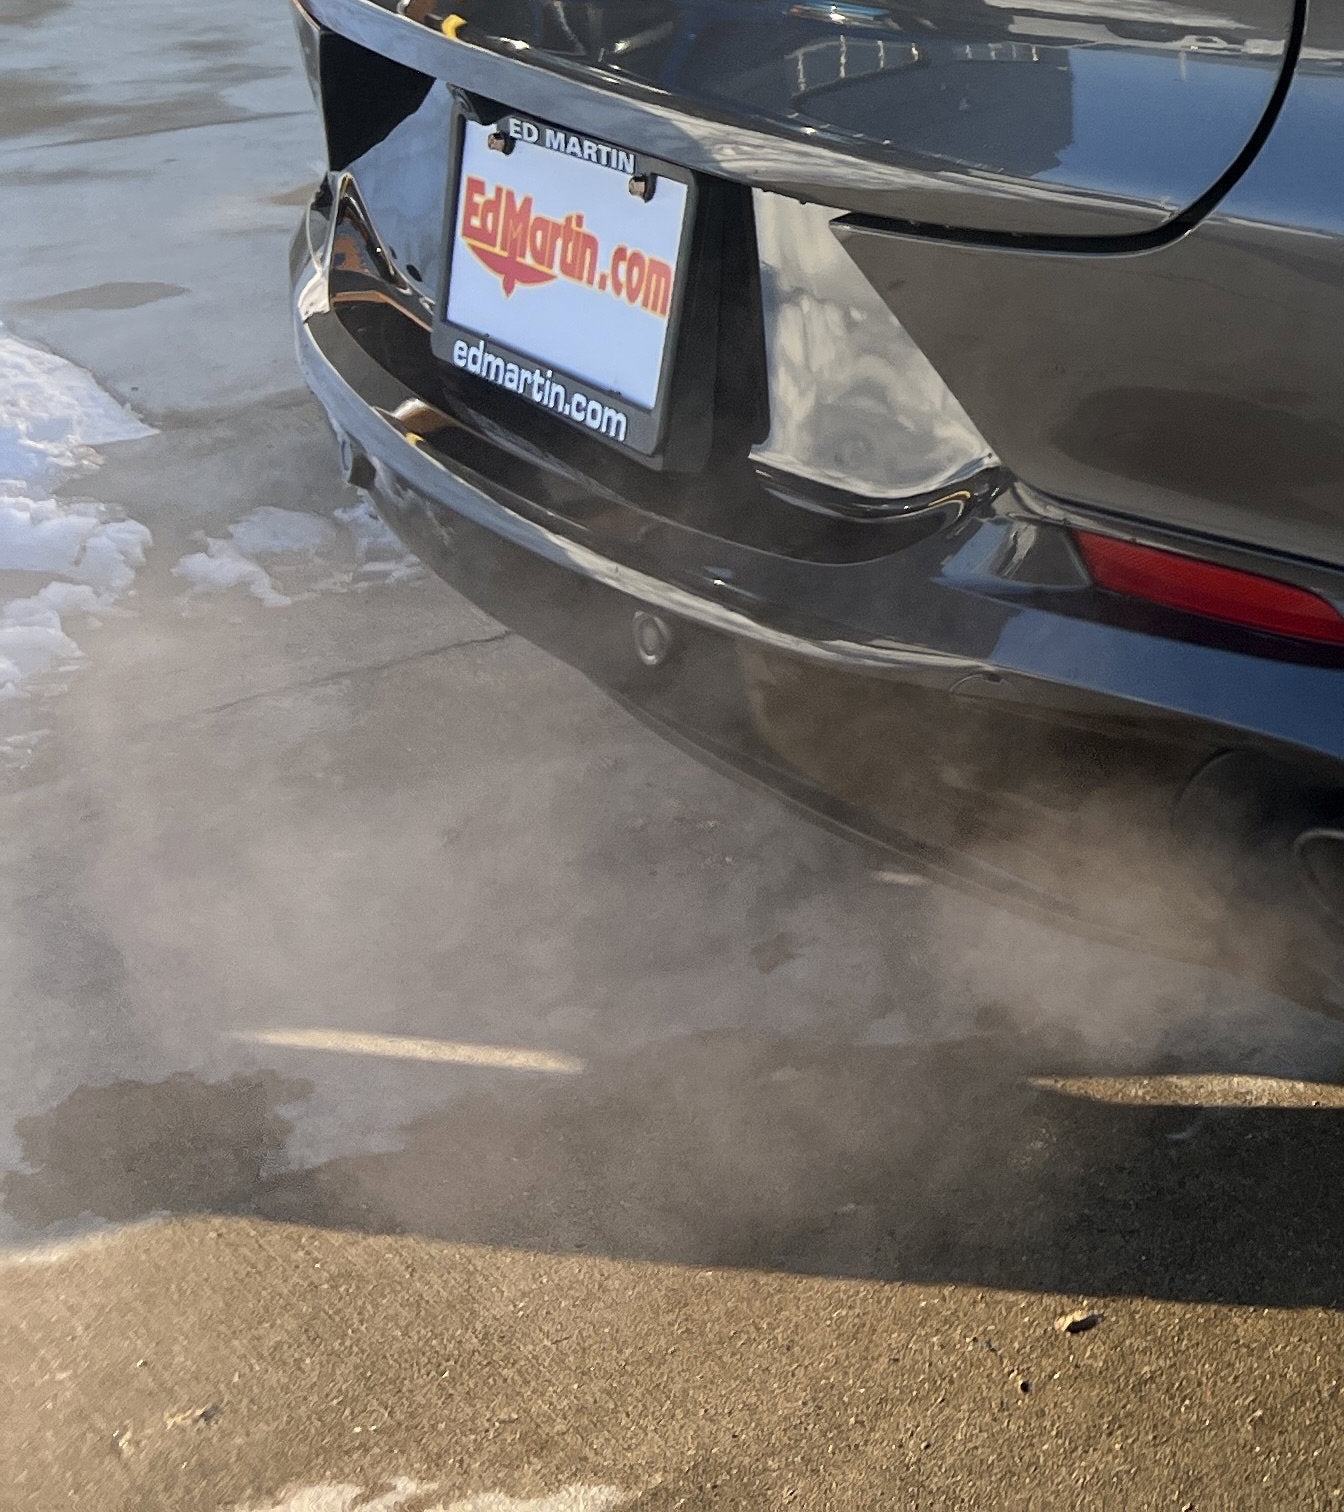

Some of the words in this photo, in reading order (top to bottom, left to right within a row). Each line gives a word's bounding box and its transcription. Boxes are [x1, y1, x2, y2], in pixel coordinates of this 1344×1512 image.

[508, 117, 539, 143] ED
[545, 128, 635, 174] MARTIN
[462, 175, 675, 318] EdMartin.com
[453, 339, 627, 442] edmartin.com
